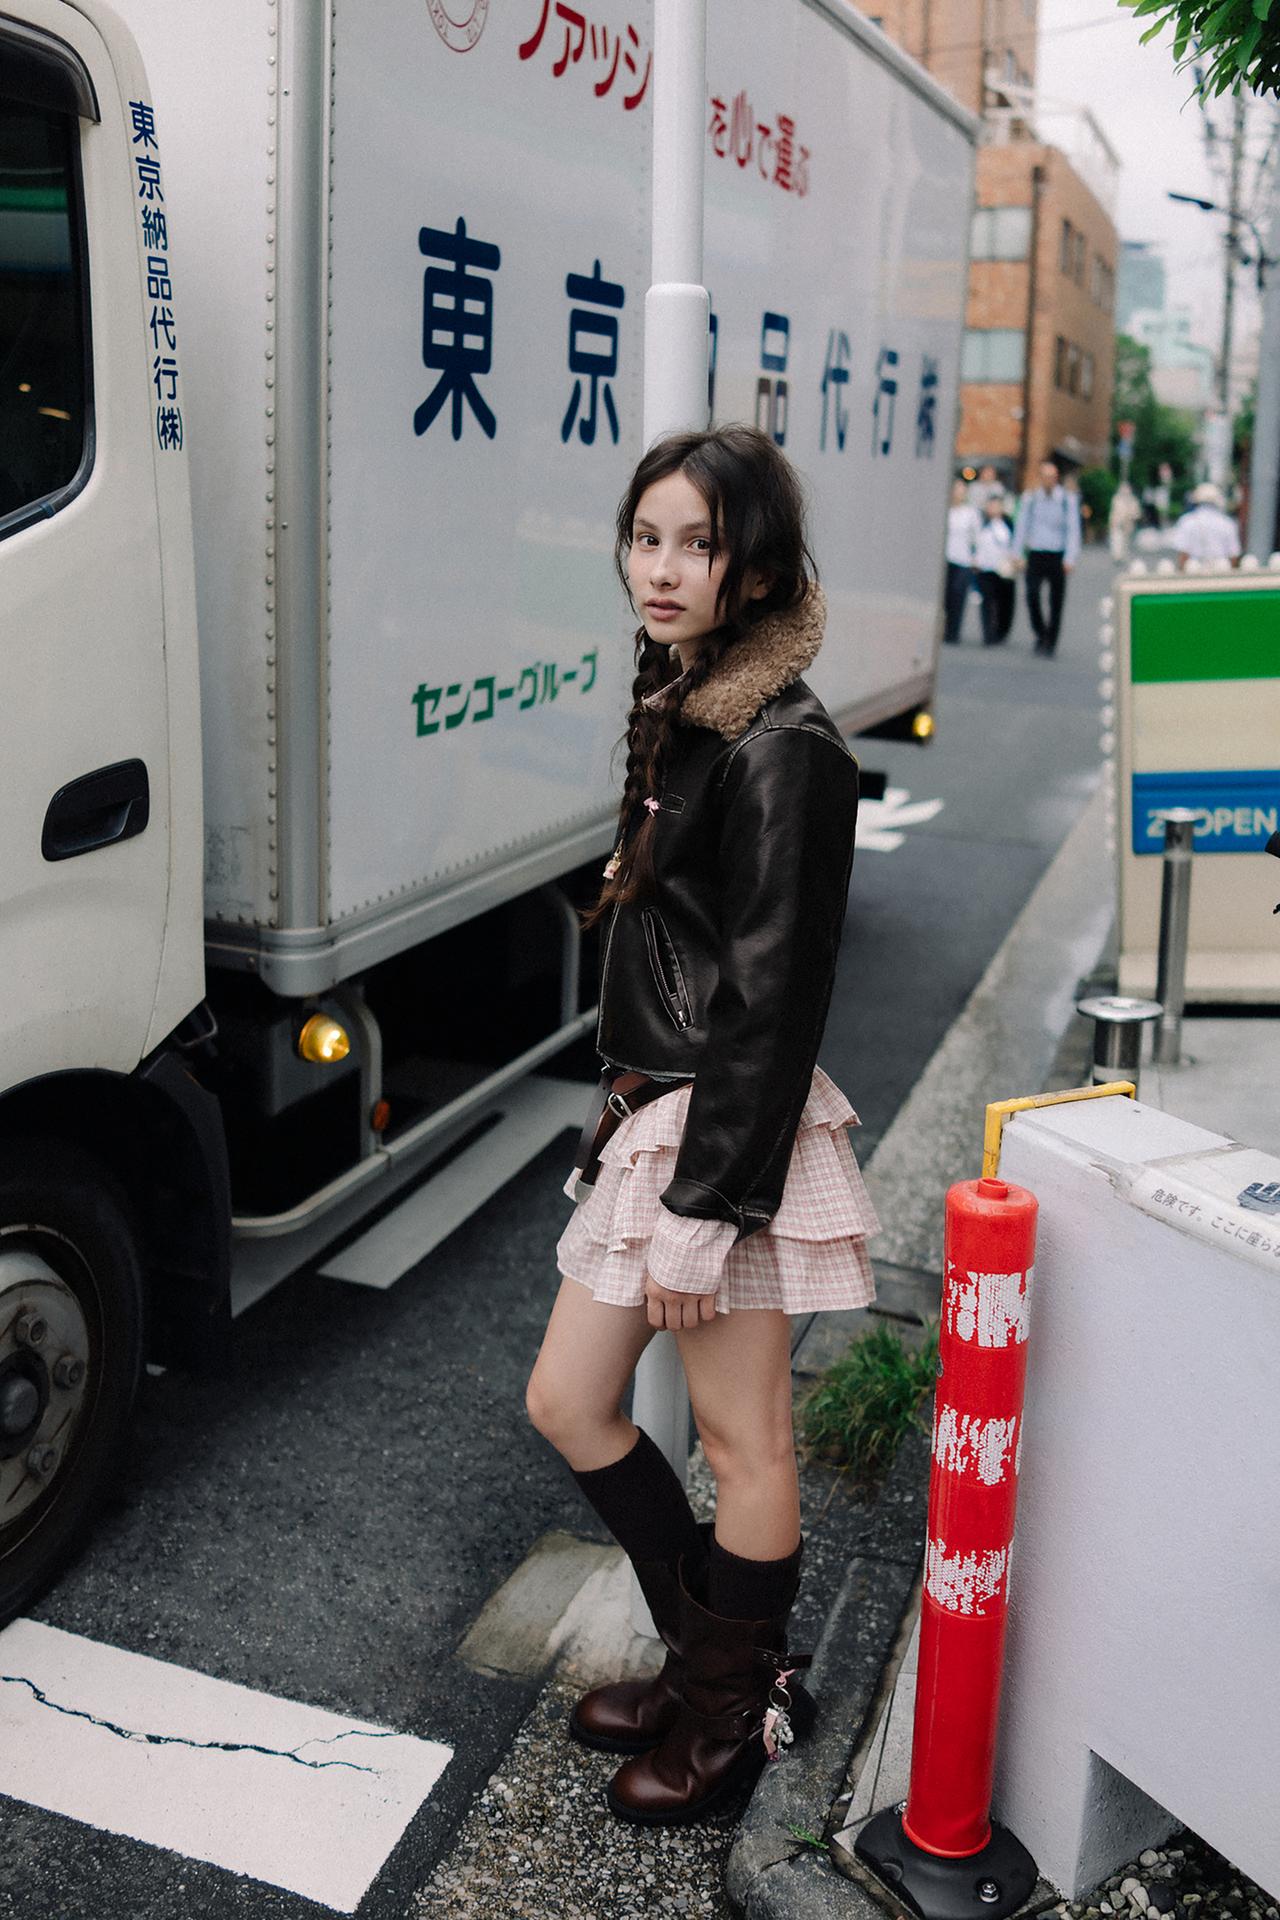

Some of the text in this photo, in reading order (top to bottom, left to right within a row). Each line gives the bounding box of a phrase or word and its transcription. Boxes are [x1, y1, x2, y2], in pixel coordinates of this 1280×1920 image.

[411, 647, 598, 738] センコーグループ
